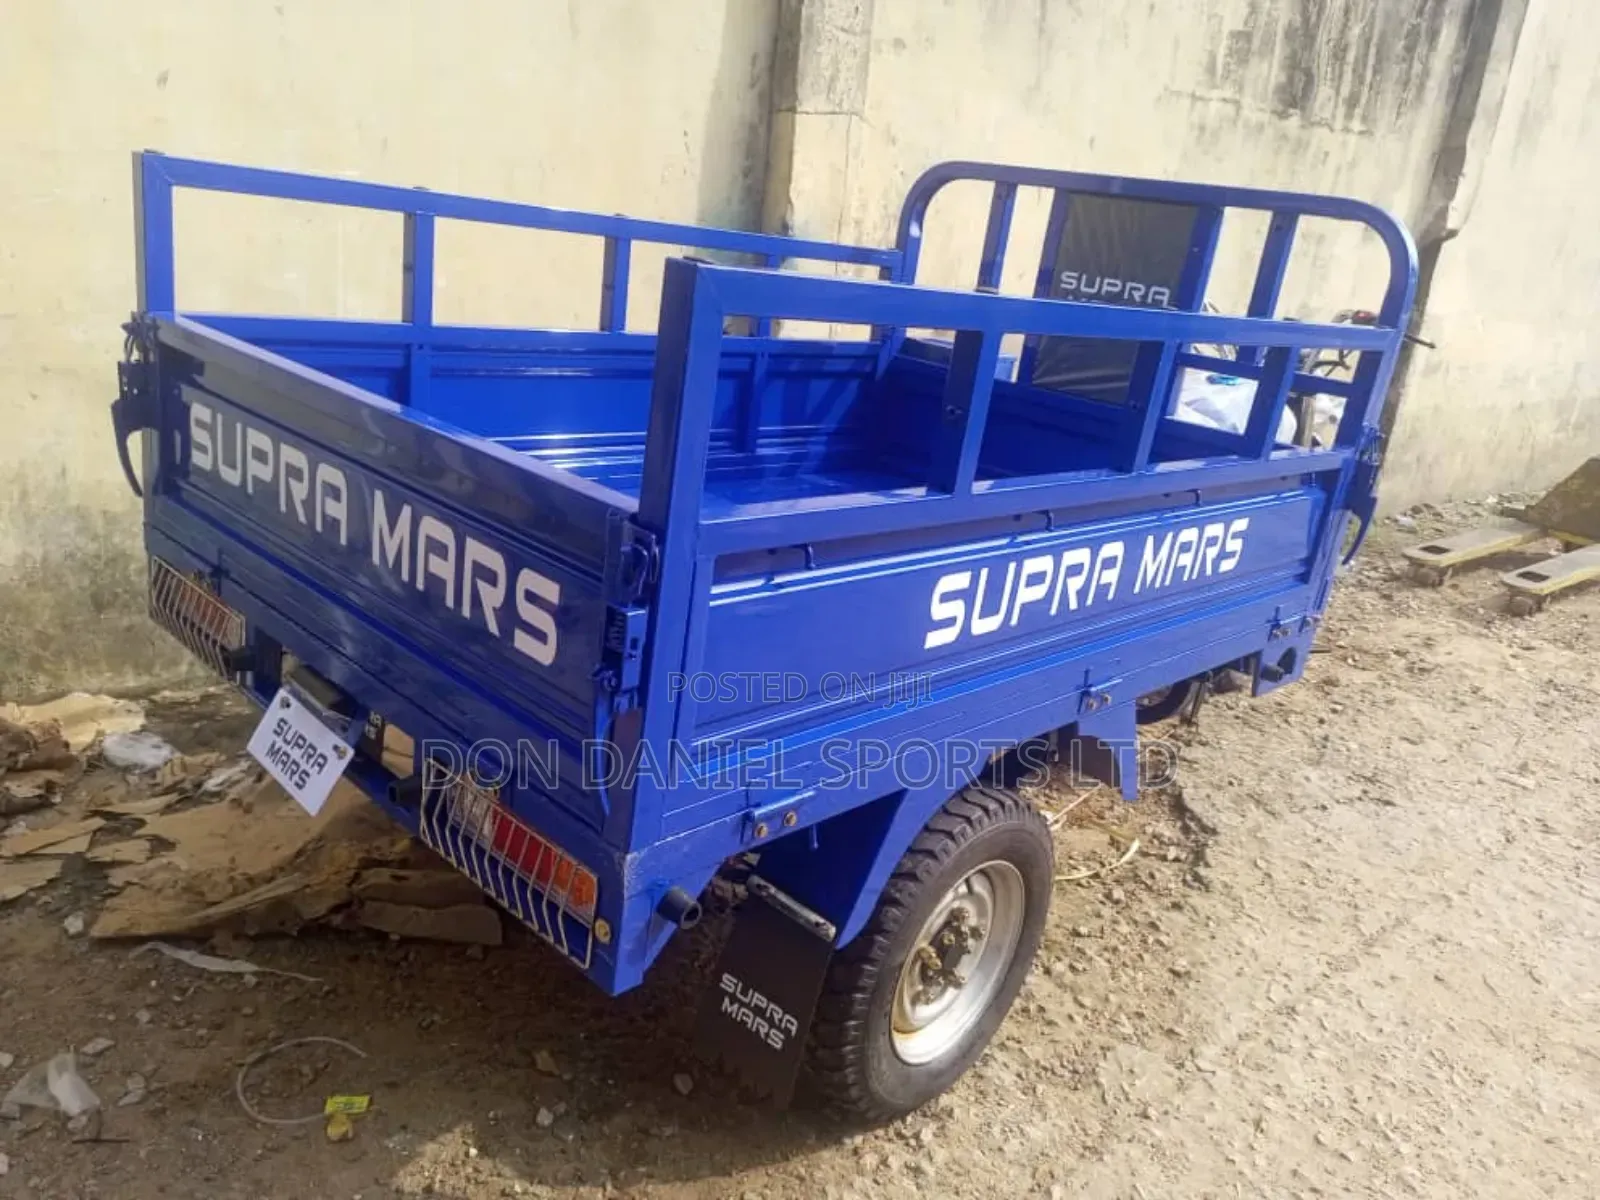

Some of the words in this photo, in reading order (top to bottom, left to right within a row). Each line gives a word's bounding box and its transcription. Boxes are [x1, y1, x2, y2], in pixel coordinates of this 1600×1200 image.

[1060, 271, 1170, 308] SUPRA
[188, 401, 348, 546] SUPRA
[371, 488, 561, 666] MARS
[924, 541, 1125, 650] SUPRA
[1133, 517, 1250, 595] MARS
[264, 740, 311, 791] MARS
[272, 717, 329, 775] SUPRA
[719, 972, 799, 1037] SUPRA
[721, 995, 785, 1050] MARS
